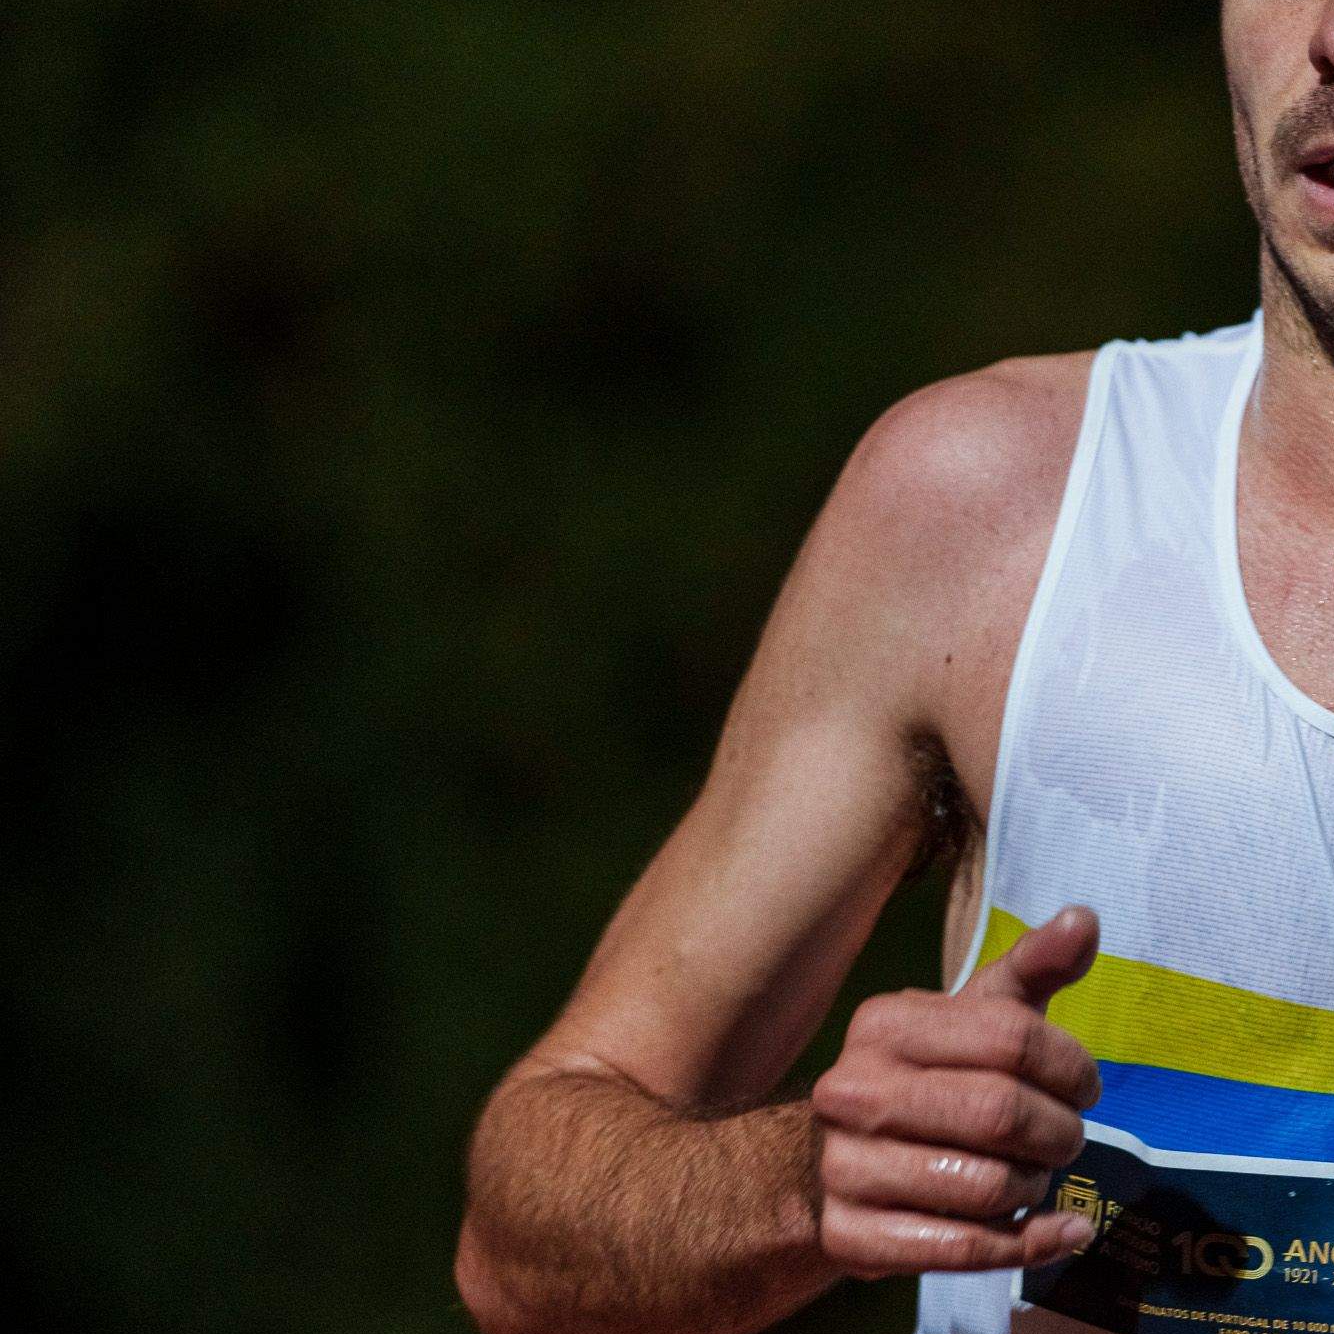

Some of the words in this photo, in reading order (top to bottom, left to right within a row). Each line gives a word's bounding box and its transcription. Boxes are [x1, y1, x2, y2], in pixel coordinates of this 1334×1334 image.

[1284, 1267, 1318, 1284] 1921
[1190, 1310, 1208, 1321] DE
[1208, 1312, 1271, 1329] PORTUGAL
[1272, 1319, 1289, 1330] DE
